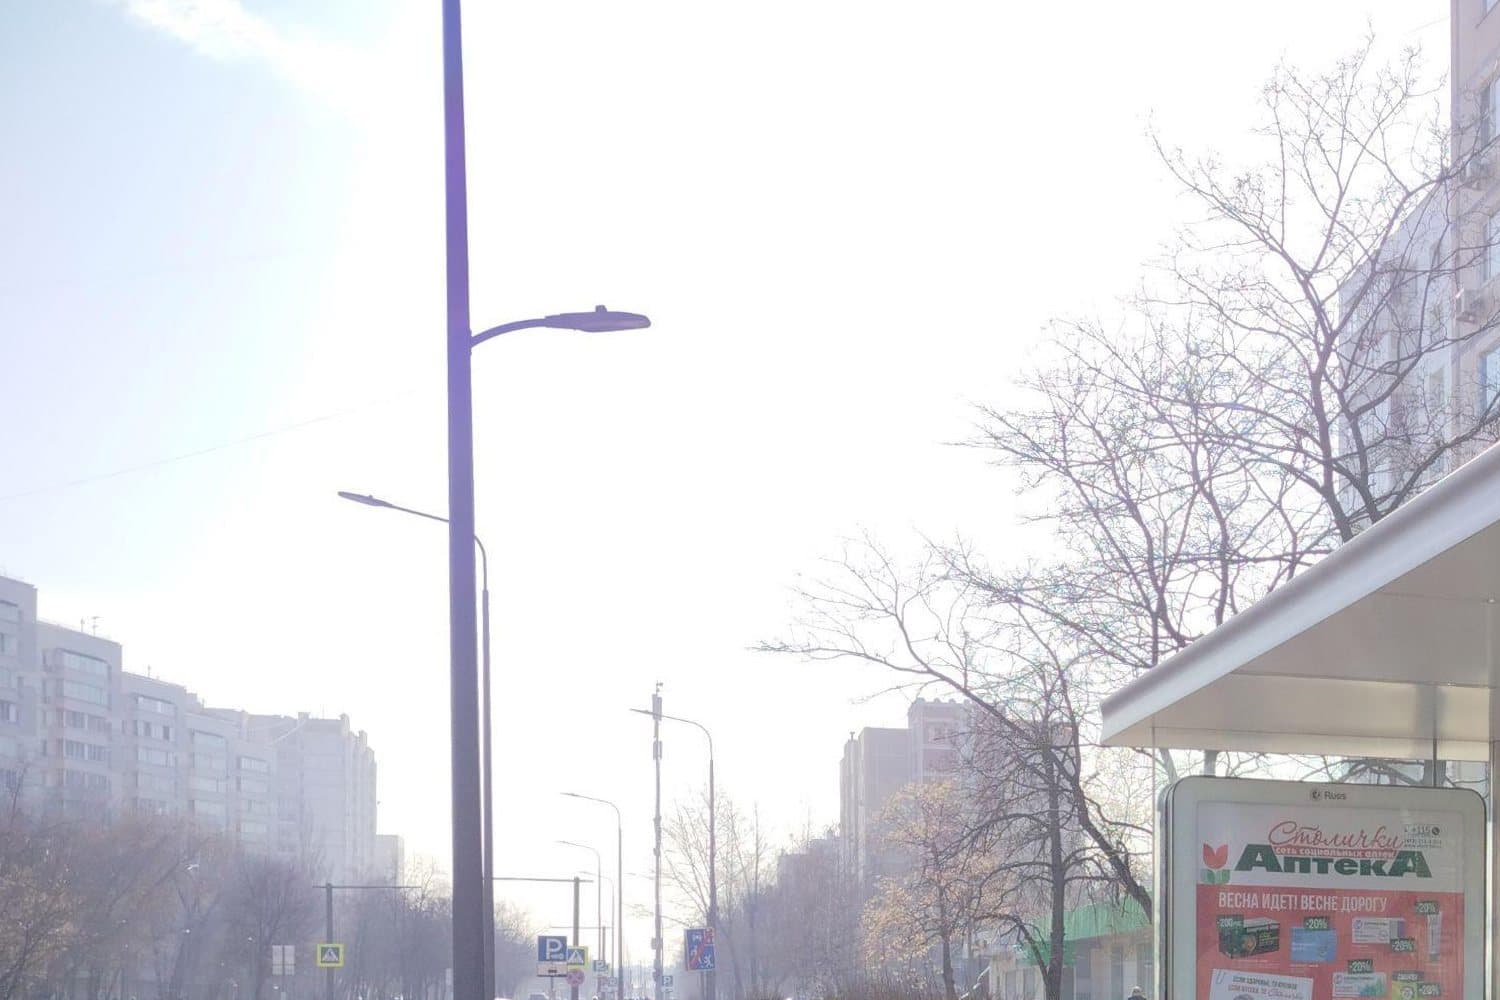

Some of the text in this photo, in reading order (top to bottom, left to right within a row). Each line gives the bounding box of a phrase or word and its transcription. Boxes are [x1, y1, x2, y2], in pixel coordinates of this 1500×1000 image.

[1267, 820, 1404, 850] Столички
[1218, 891, 1388, 913] ВЕСНА ИДЕТ! ВЕСНЕ ДОРОГУ
[1305, 918, 1329, 929] -20%
